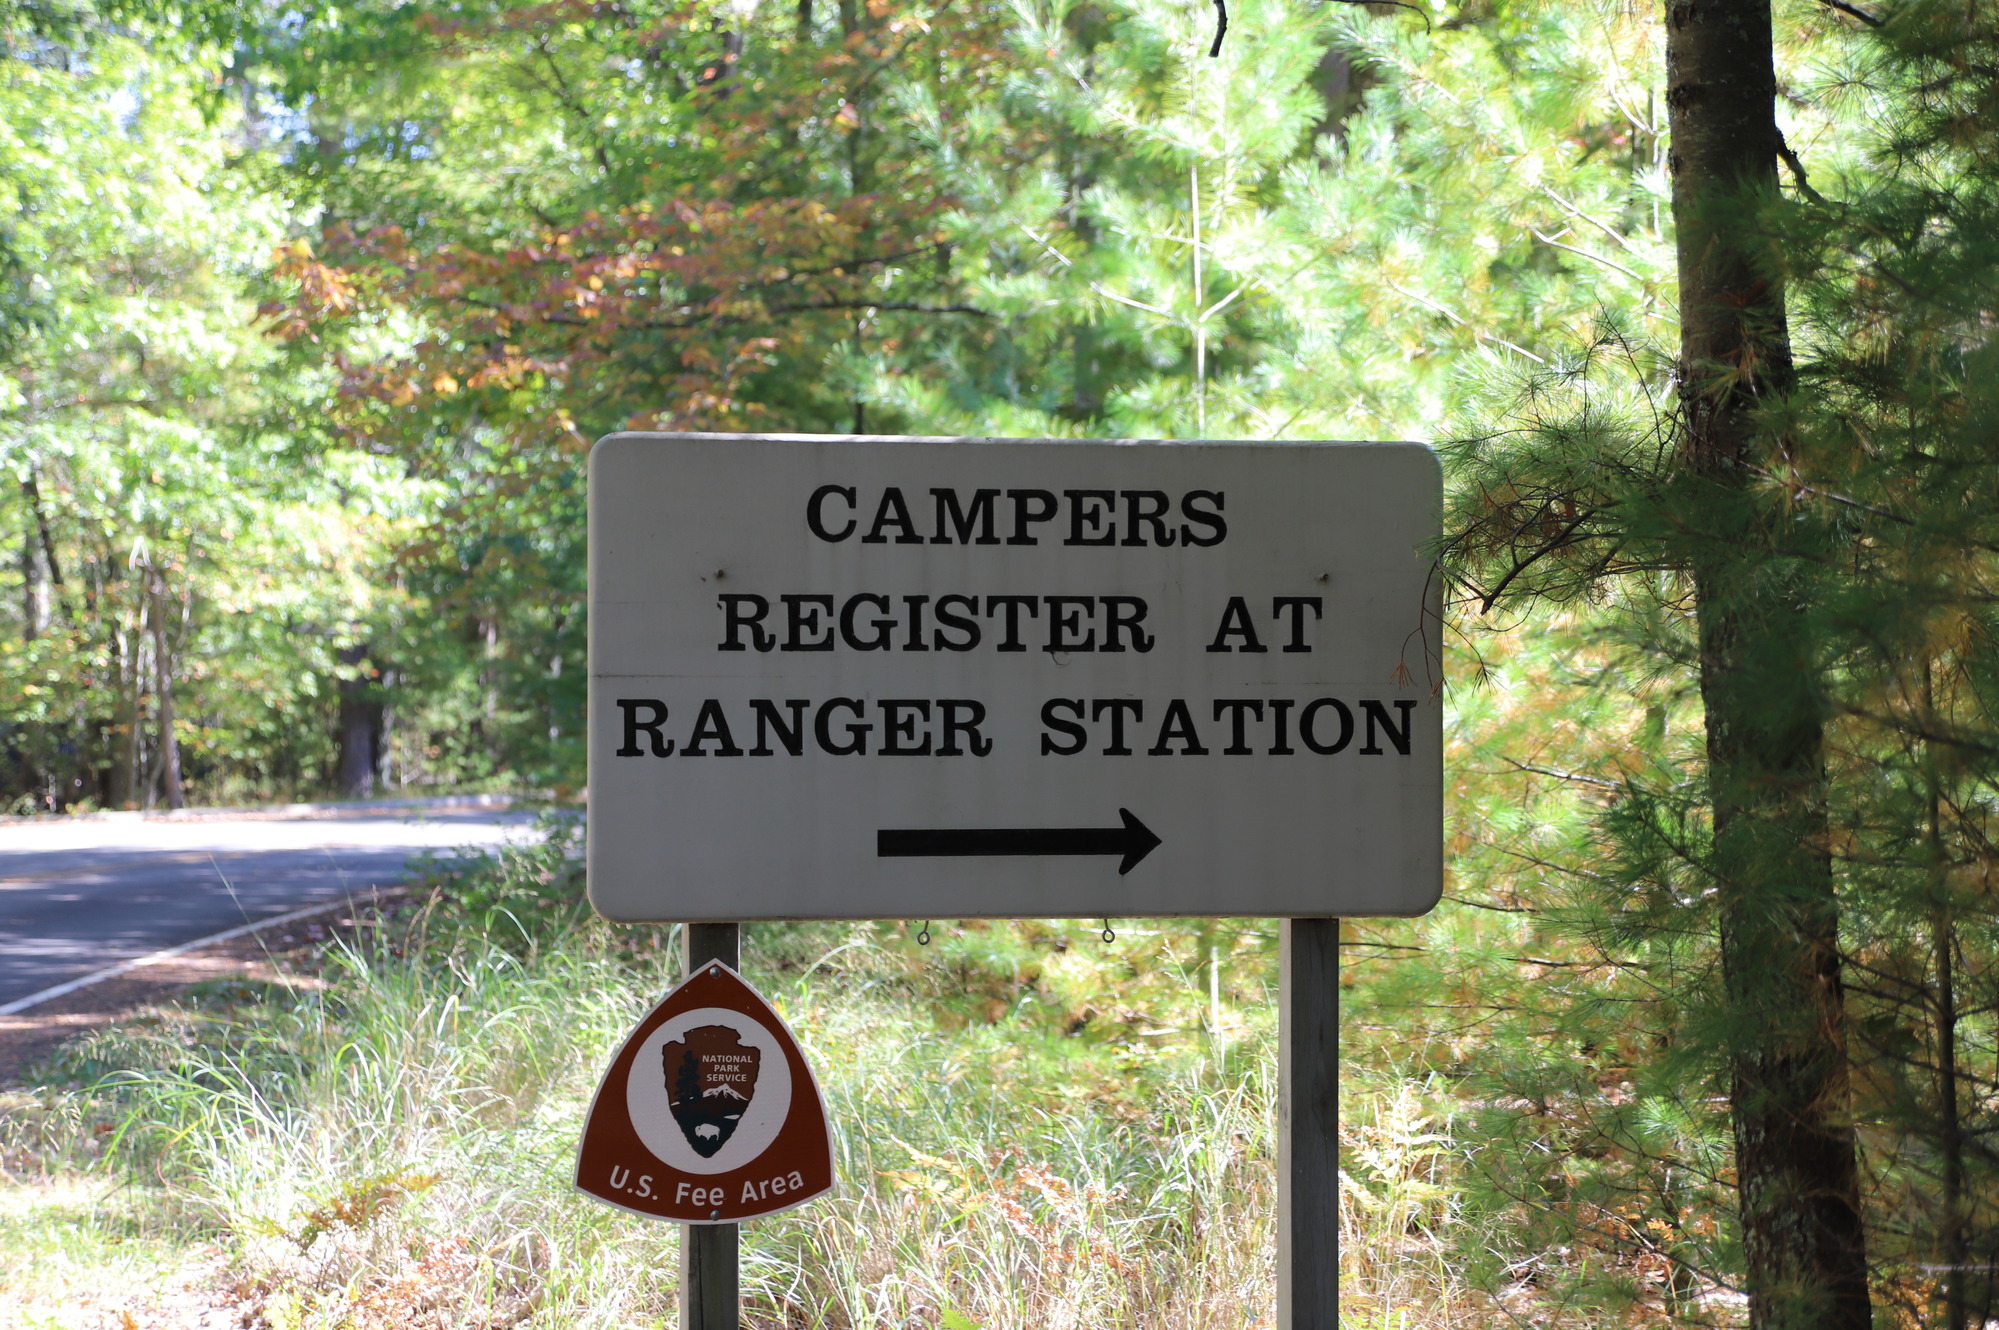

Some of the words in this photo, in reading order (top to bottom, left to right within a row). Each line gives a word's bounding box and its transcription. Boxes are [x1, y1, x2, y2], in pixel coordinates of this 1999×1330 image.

[806, 484, 1227, 547] CAMPERS
[717, 593, 1156, 653] REGISTER
[1205, 595, 1324, 655] AT
[616, 697, 993, 759] RANGER
[1041, 697, 1419, 760] STATION
[702, 1054, 753, 1063] NATIONAL
[706, 1073, 747, 1082] SERVICE
[714, 1064, 740, 1072] PARK
[609, 1165, 658, 1200] U.S.
[675, 1182, 724, 1206] Fee
[740, 1170, 804, 1204] Area
